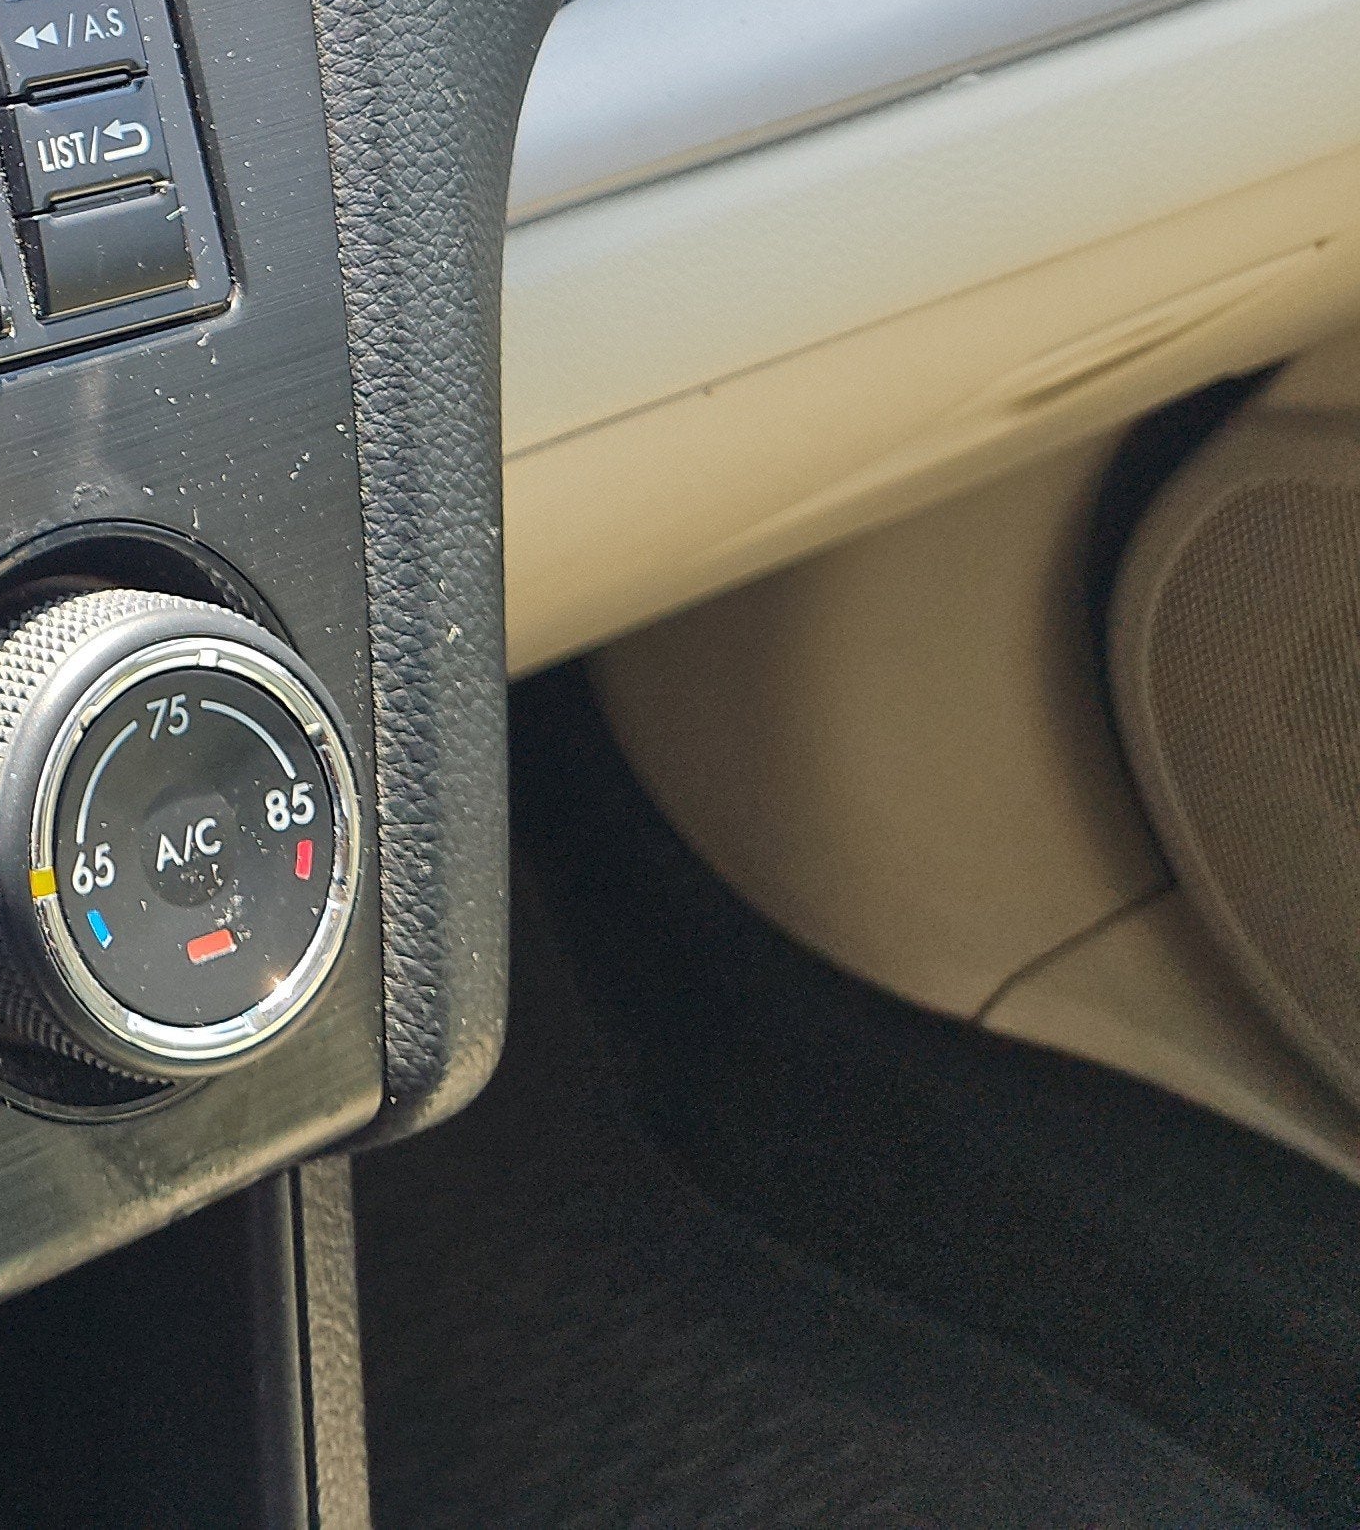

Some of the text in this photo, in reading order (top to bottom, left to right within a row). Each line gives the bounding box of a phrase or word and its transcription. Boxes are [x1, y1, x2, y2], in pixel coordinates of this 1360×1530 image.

[146, 694, 192, 740] 75
[264, 783, 316, 832] 85
[72, 842, 116, 895] 65
[156, 817, 223, 872] A/C
